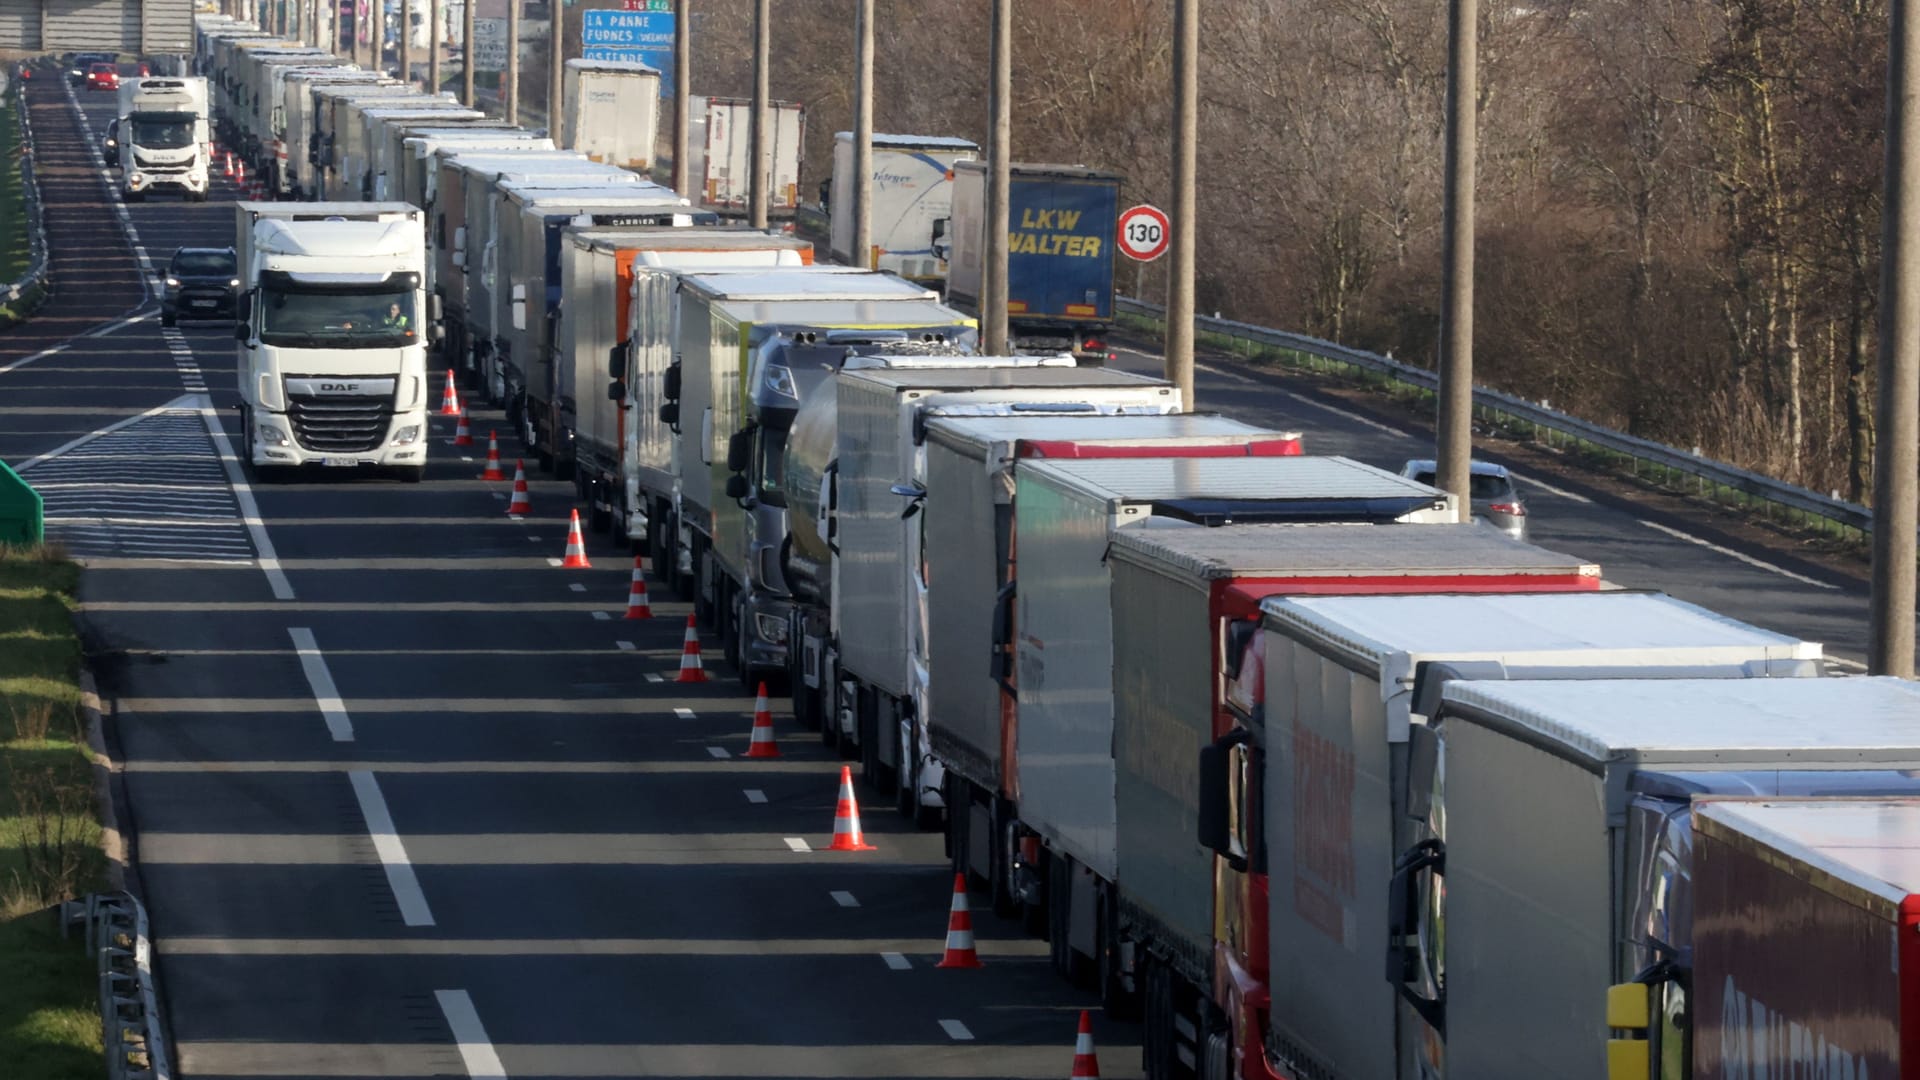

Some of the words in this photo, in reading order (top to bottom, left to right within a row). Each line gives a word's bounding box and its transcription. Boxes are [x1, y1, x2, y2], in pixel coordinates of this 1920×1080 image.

[587, 15, 602, 27] LA
[610, 15, 649, 28] PANNE
[587, 30, 633, 41] FURNES
[613, 218, 655, 226] CARRIER
[1021, 208, 1081, 231] LKW
[1128, 224, 1161, 243] 130
[1008, 232, 1102, 257] WALTER
[320, 383, 360, 391] DAF
